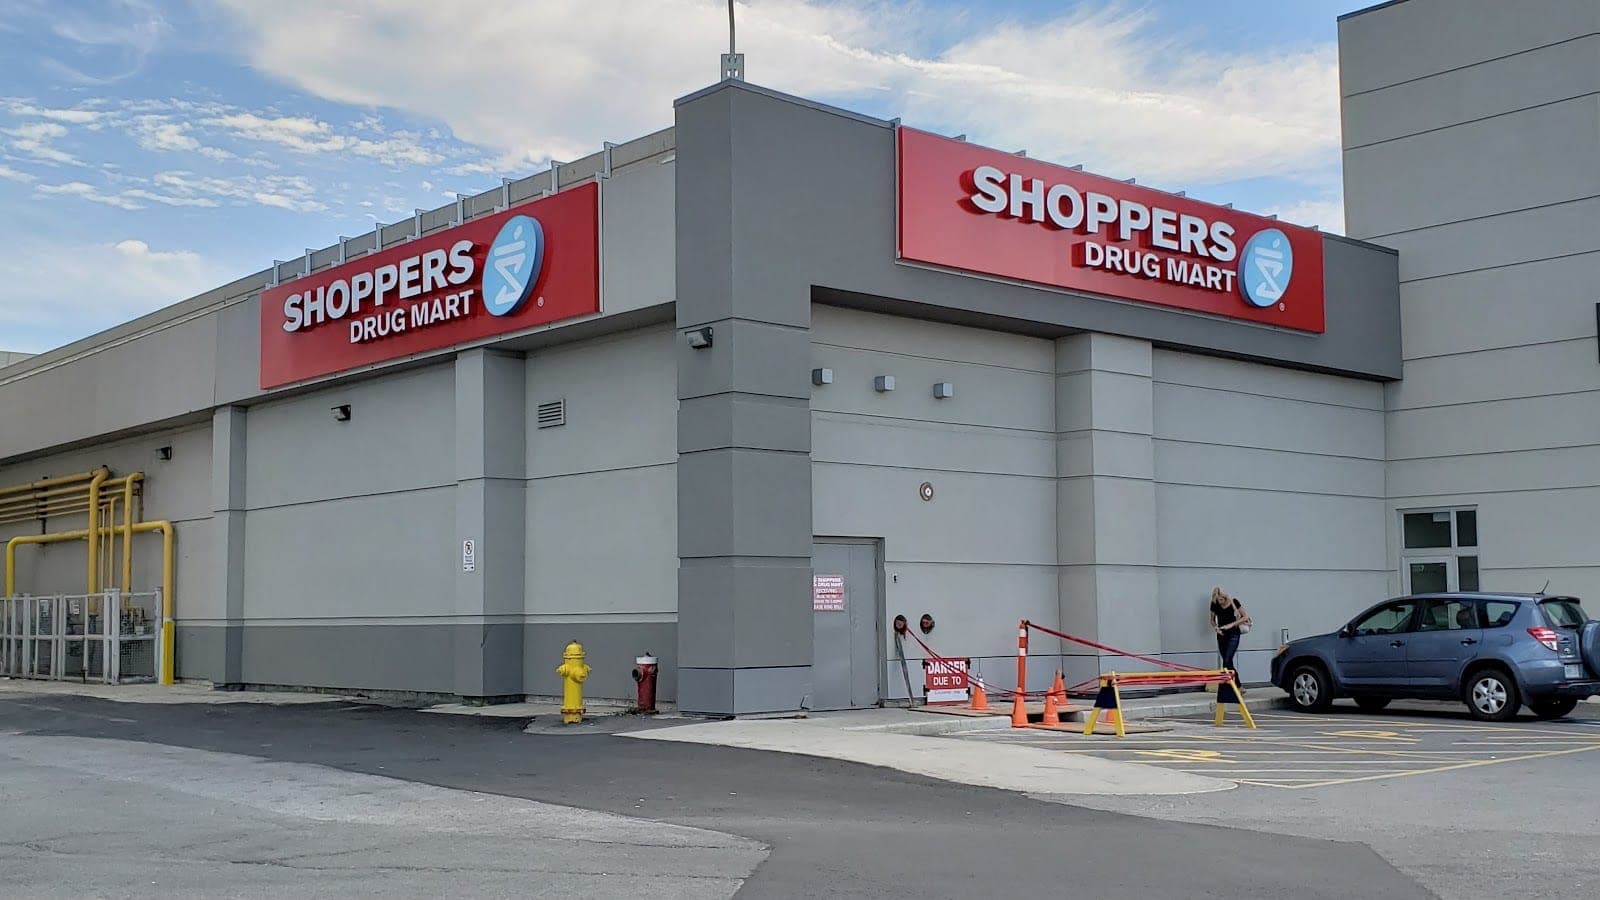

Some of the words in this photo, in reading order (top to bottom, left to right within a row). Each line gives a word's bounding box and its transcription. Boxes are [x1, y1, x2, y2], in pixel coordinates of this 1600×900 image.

[969, 165, 1237, 262] SHOPPERS
[283, 240, 475, 333] SHOPPERS
[1085, 241, 1160, 279] DRUG
[1167, 260, 1237, 293] MART
[350, 308, 406, 344] DRUG
[411, 289, 474, 329] MART
[927, 660, 967, 675] DANGER
[933, 676, 949, 686] DUE
[951, 676, 962, 686] TO
